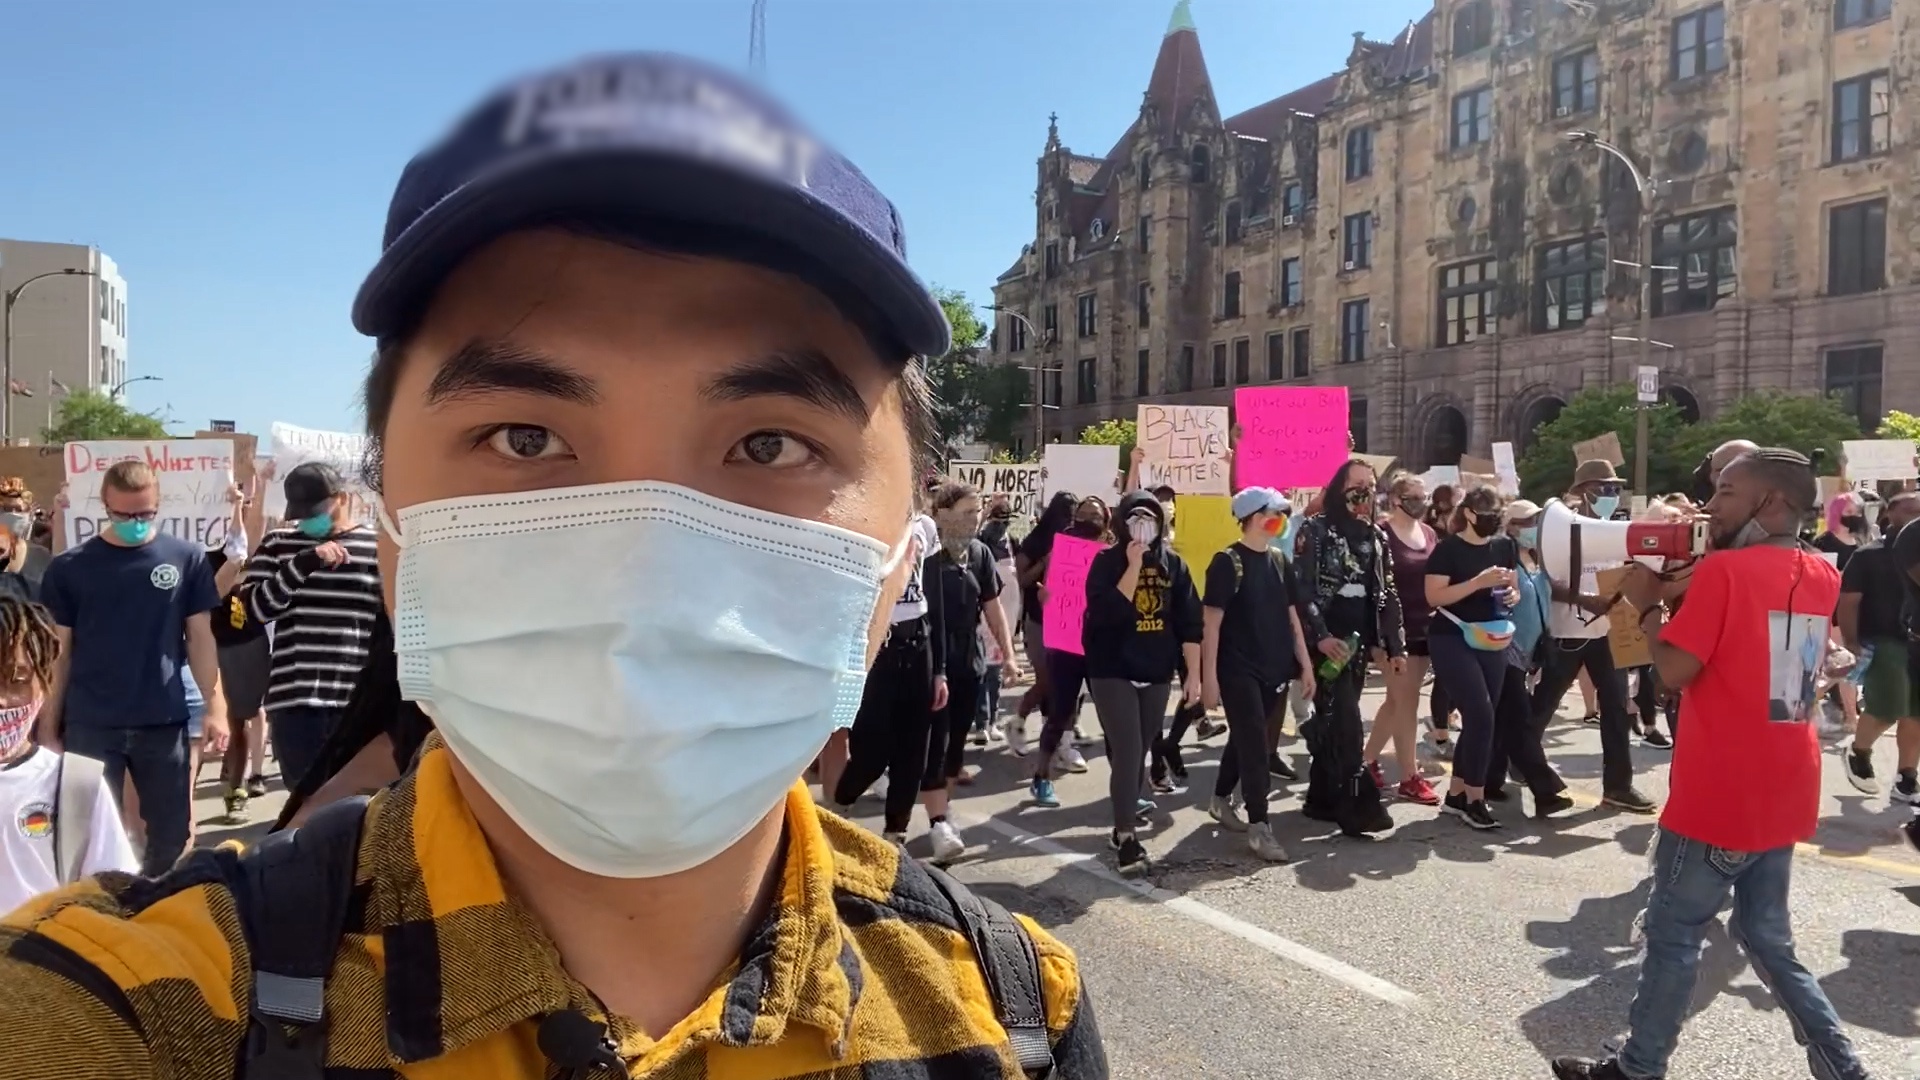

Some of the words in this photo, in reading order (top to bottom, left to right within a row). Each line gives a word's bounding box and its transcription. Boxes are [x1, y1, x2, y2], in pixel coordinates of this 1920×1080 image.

[1146, 407, 1217, 440] BLACK
[1168, 431, 1228, 460] LIVES
[69, 444, 140, 473] DE
[145, 444, 231, 476] WHITES
[1149, 462, 1221, 485] MATTER
[958, 467, 986, 491] NO
[994, 468, 1040, 492] MORE
[1136, 620, 1164, 632] 2012
